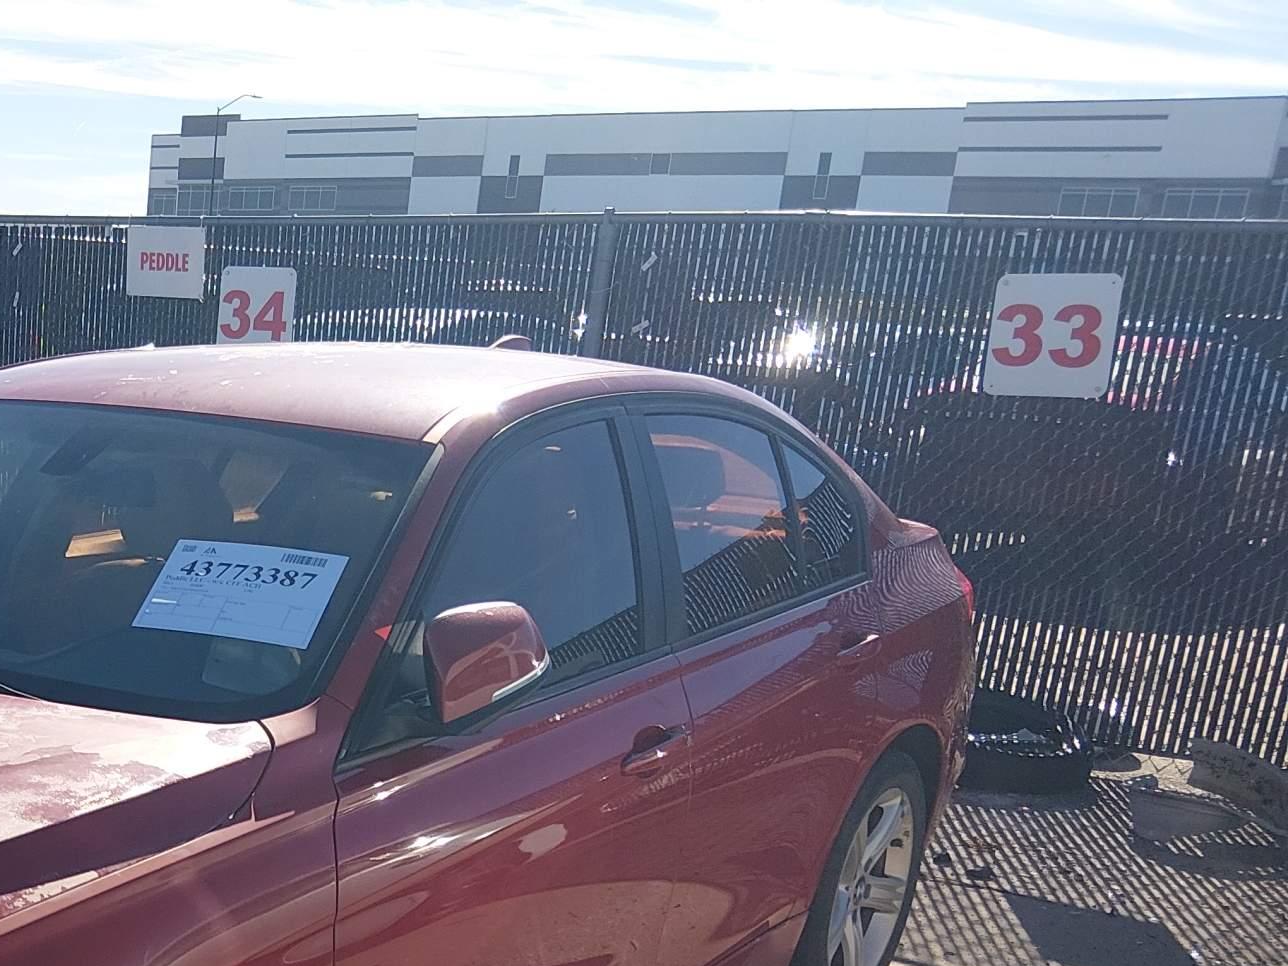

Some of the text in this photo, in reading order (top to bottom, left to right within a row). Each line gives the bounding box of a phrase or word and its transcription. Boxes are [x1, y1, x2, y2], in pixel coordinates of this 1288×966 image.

[140, 251, 190, 273] PEDDLE
[220, 289, 287, 342] 34
[991, 303, 1103, 369] 33
[180, 559, 319, 590] 43773387
